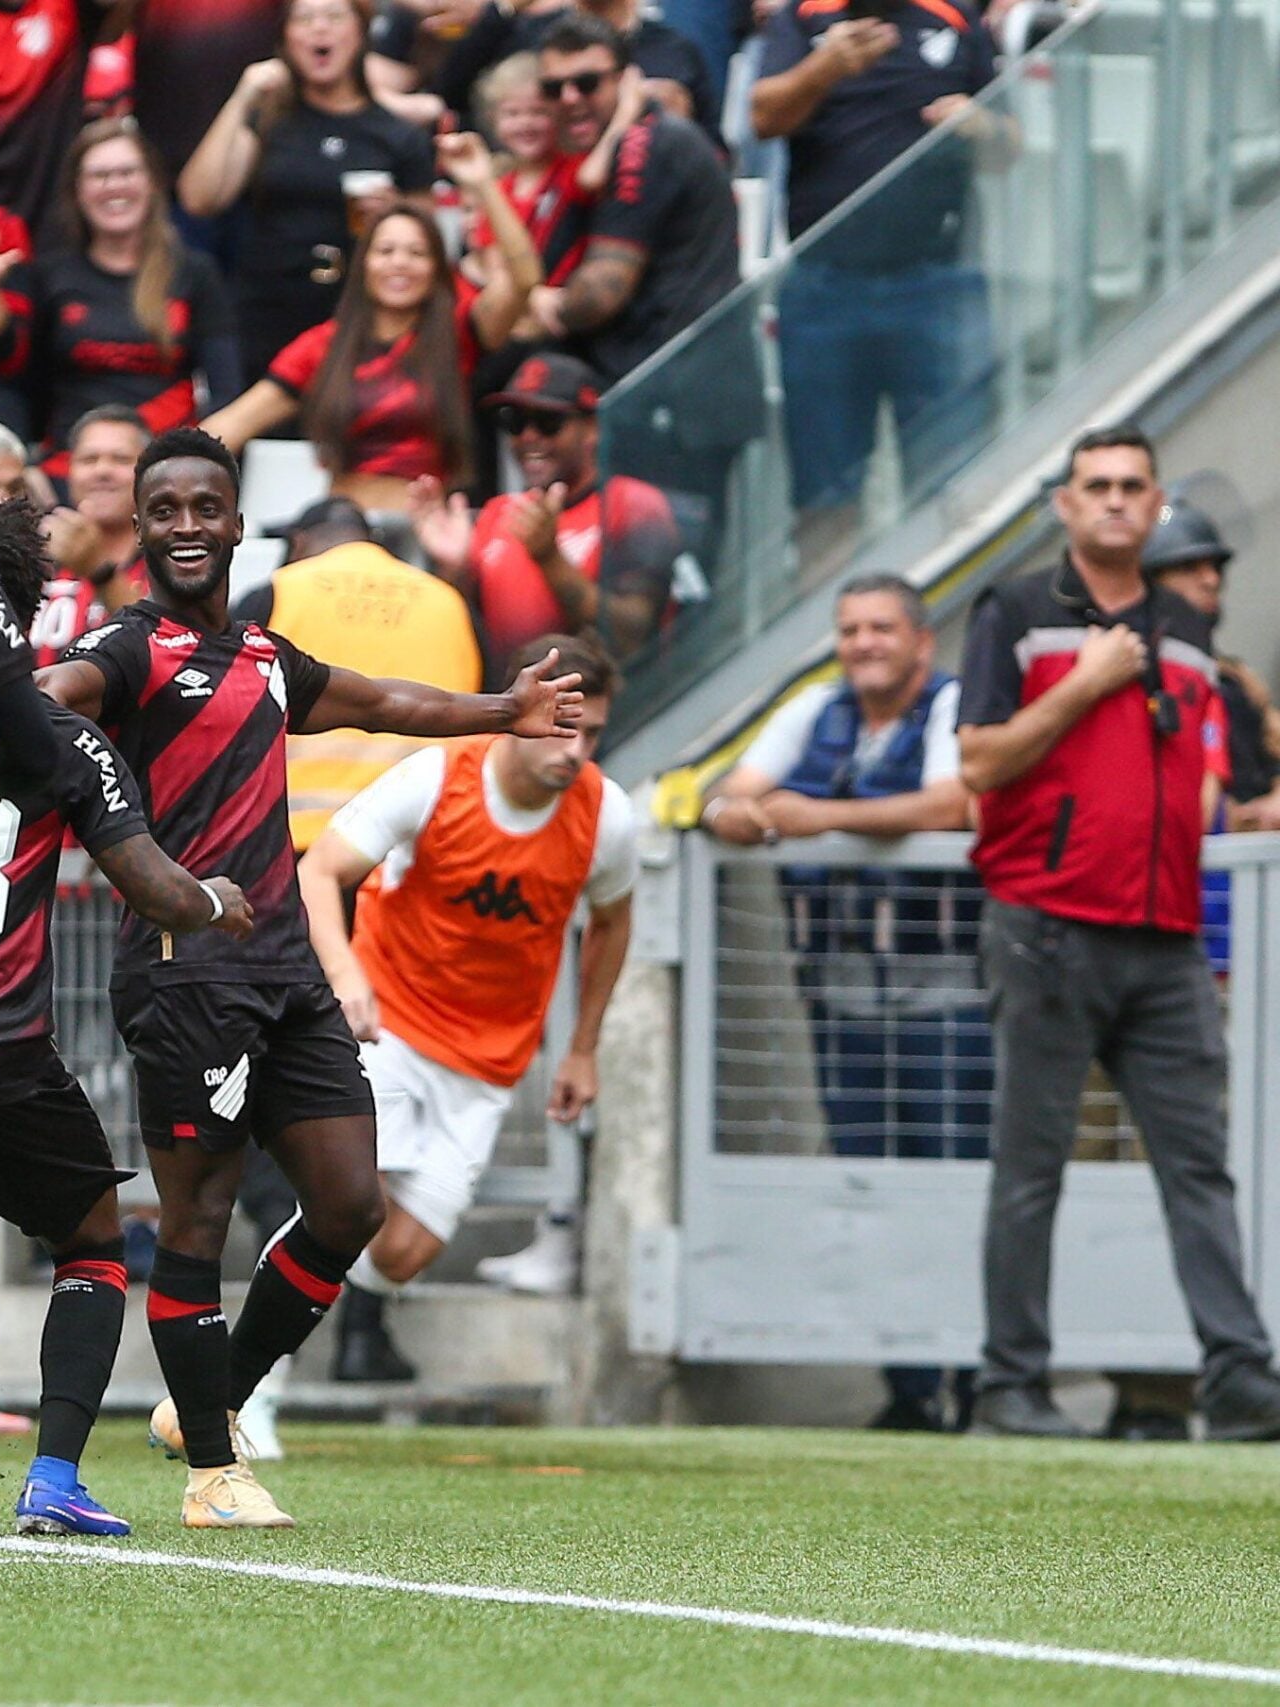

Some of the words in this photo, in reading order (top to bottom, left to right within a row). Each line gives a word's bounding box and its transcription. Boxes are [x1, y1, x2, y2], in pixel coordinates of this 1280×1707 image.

[180, 686, 214, 699] umbro
[72, 728, 129, 814] HAVAN
[203, 1065, 229, 1088] CAP
